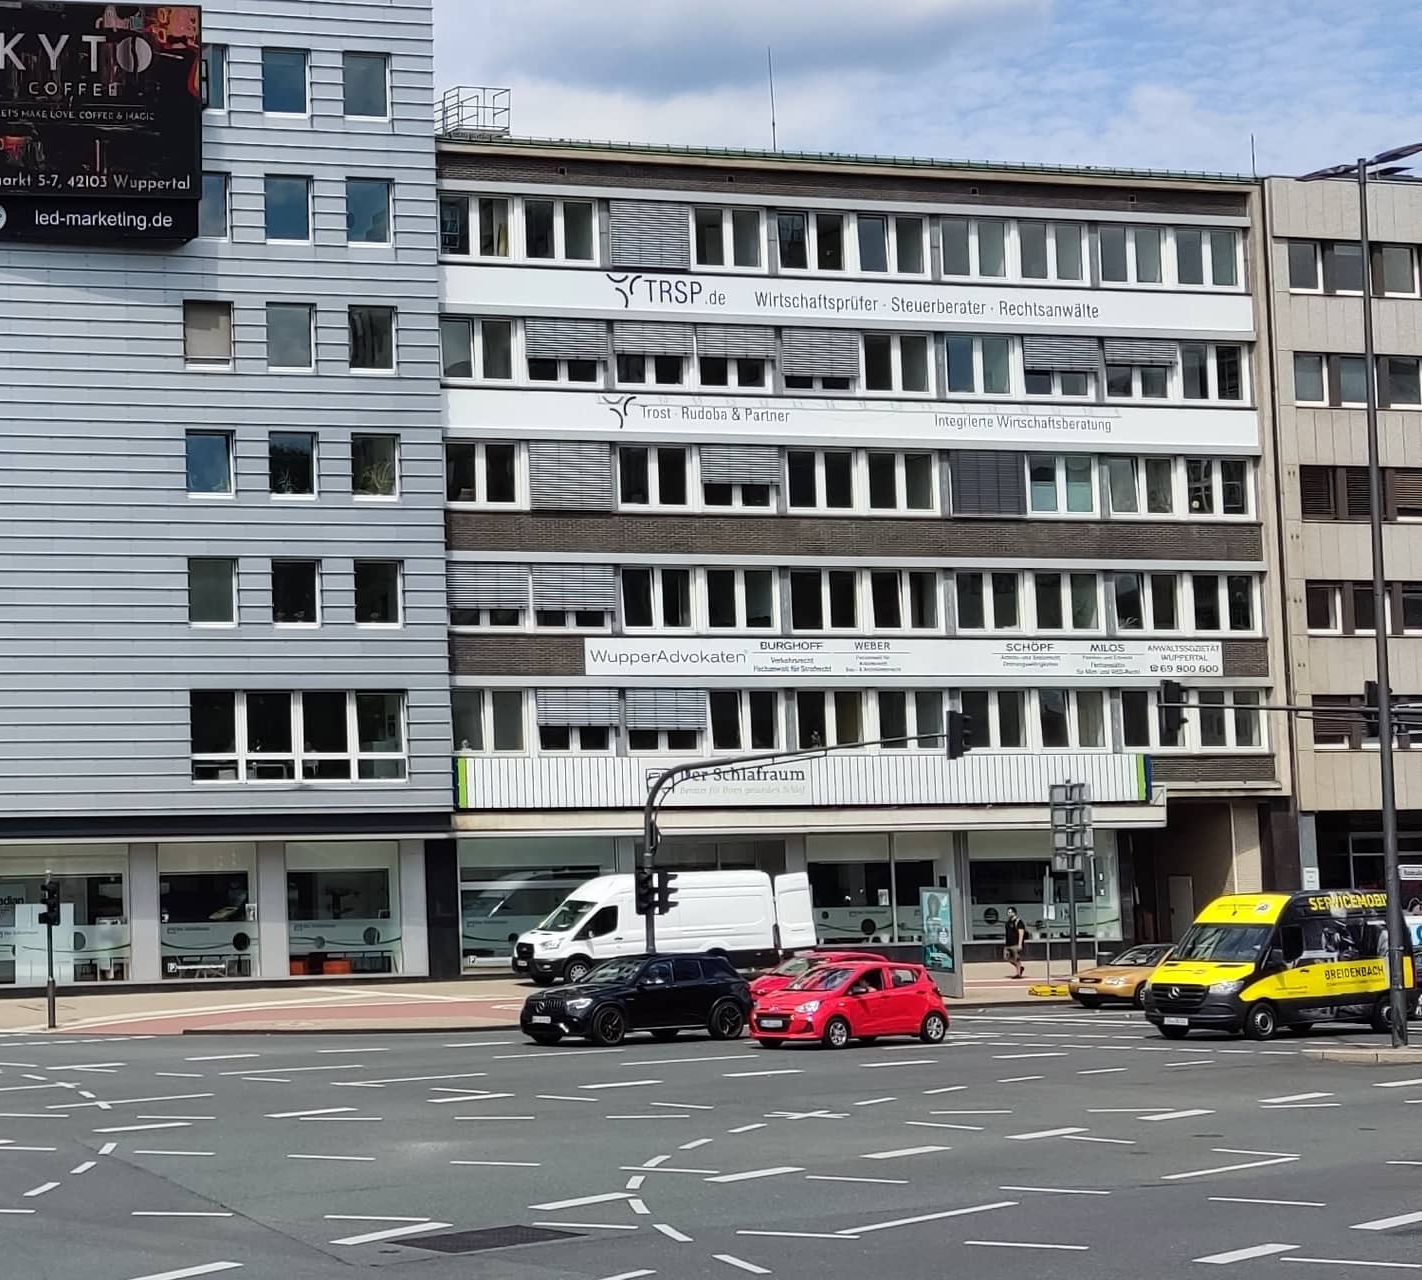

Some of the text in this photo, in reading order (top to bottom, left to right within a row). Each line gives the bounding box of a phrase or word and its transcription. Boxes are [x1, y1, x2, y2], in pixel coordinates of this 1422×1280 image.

[28, 81, 123, 97] COFFEE
[50, 110, 74, 119] LOVE
[38, 174, 63, 190] 5-7,
[67, 175, 107, 189] 42103
[113, 174, 190, 192] Wuppertal
[35, 209, 173, 230] led-marketing.de
[755, 291, 878, 312] Wirtschaftsprüfer
[891, 296, 987, 315] Steuerberater
[999, 300, 1099, 318] Rechtsanwälte
[641, 405, 791, 423] Trost Rudoba & Partner
[934, 413, 1112, 433] Integrierte Wirtschaftsberatung
[760, 641, 891, 651] BURGHOFF WEBER
[1006, 641, 1126, 653] SCHÖPF MILOS
[590, 649, 746, 666] WupperAdvokaten
[714, 765, 805, 782] Schlafraum
[1309, 893, 1387, 910] SERVICEMOBI
[1325, 965, 1384, 979] BREIDENBACH
